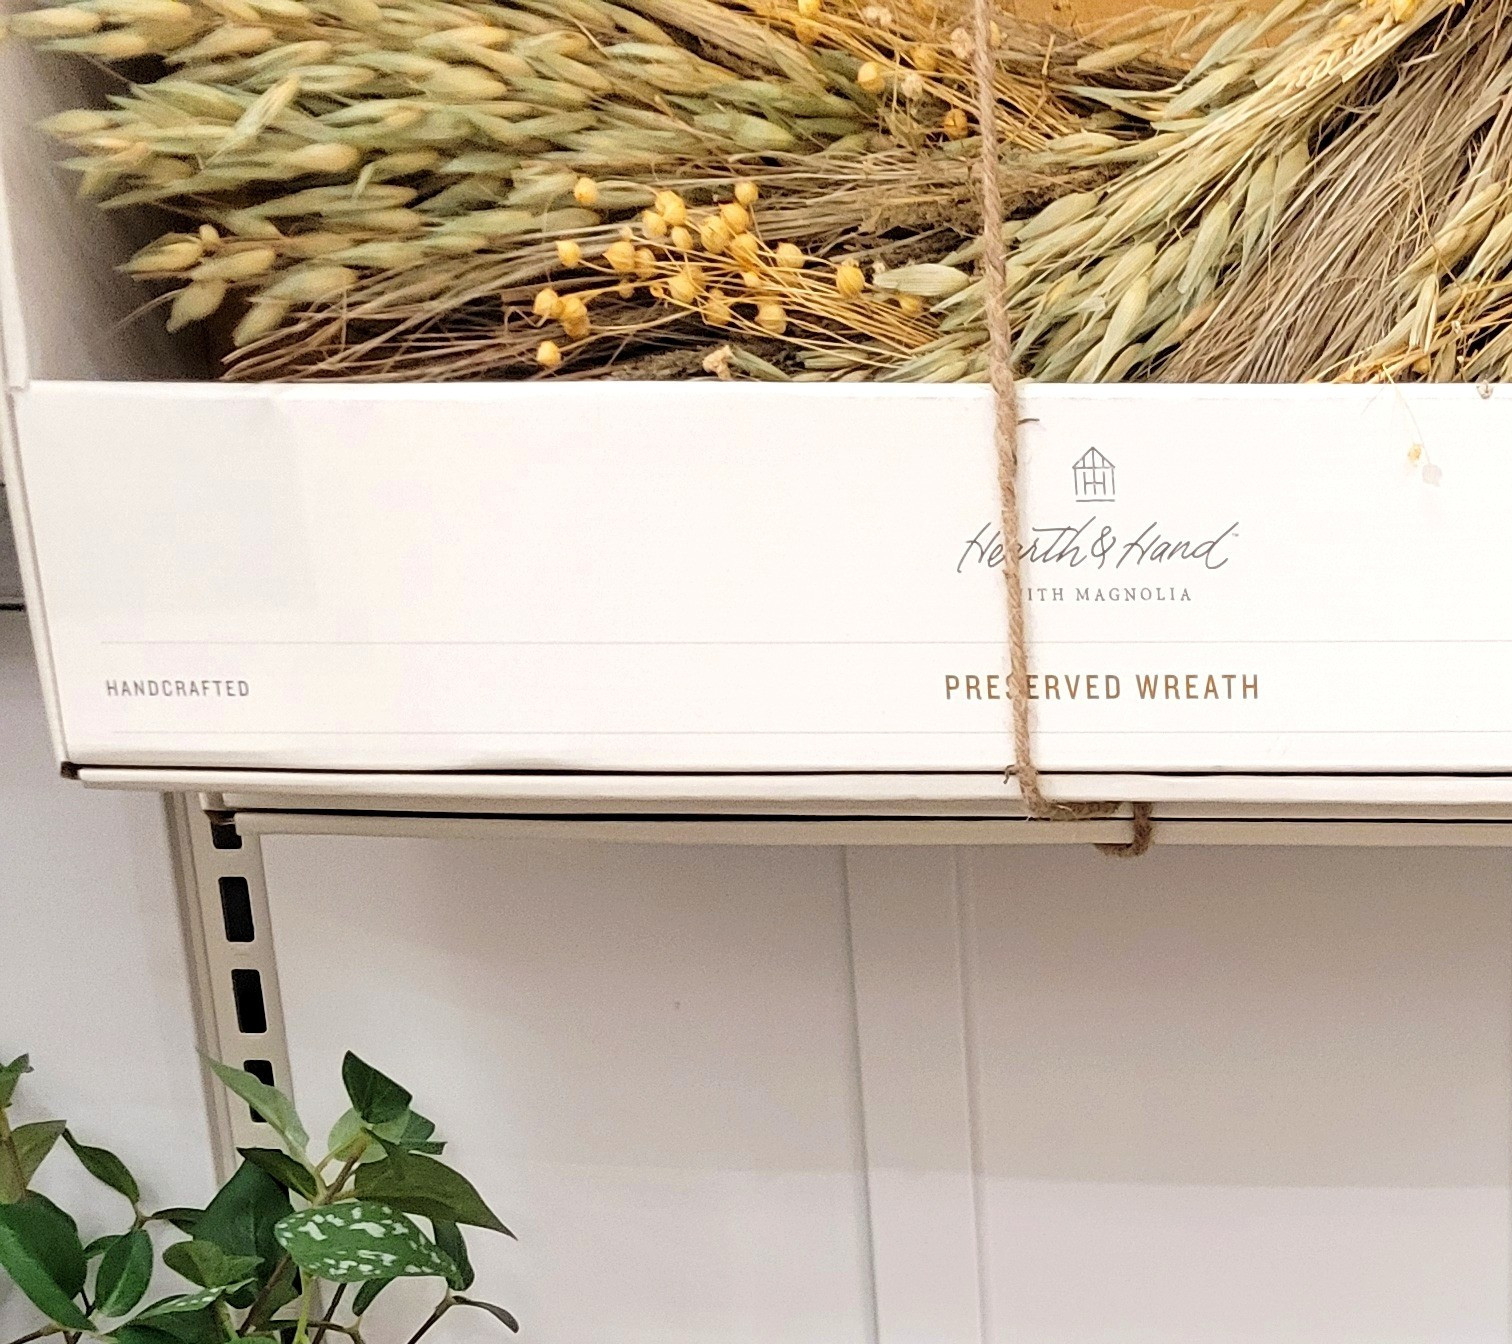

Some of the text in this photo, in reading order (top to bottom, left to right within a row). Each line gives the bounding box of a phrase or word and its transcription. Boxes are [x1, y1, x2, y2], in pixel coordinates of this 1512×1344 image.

[957, 516, 1096, 573] Herth
[1090, 525, 1117, 570] &
[1022, 587, 1193, 602] ITH MAGNOLIA
[105, 679, 251, 697] HANDCRAFTED
[1135, 674, 1259, 700] WREATH
